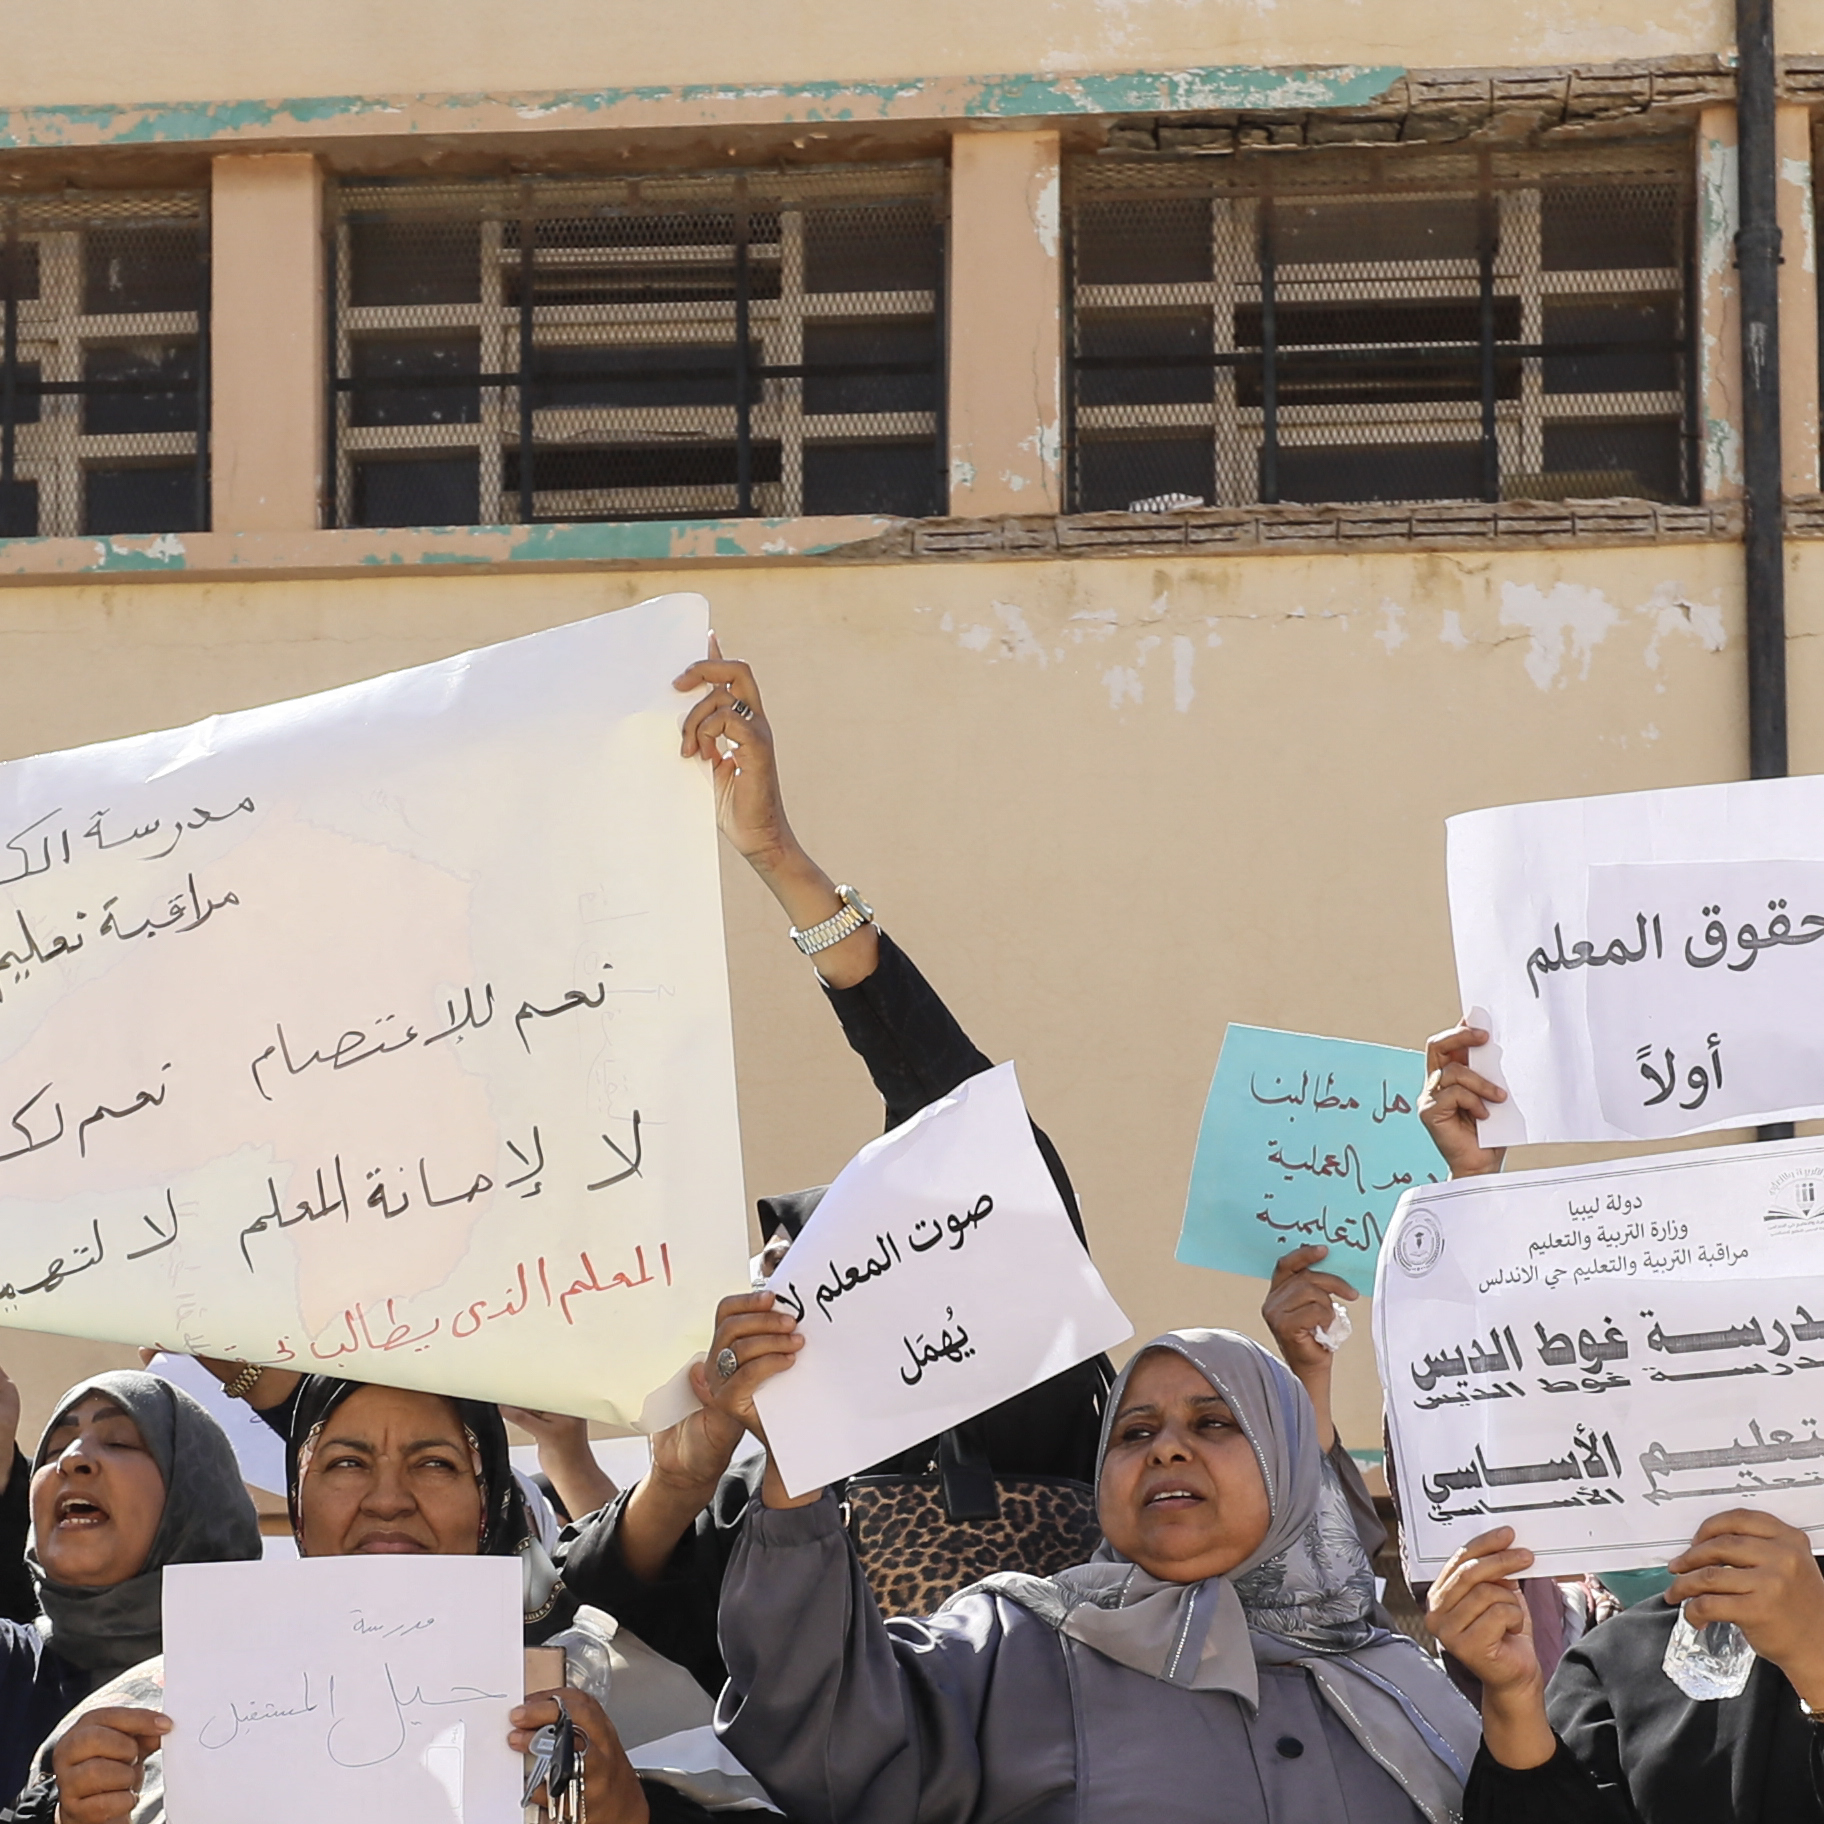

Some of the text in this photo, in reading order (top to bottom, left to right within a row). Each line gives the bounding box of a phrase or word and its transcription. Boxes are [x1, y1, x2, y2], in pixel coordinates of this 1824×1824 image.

[84, 792, 255, 859] مدرسة
[100, 873, 240, 940] مراقبة
[1526, 911, 1663, 999] المعلم
[515, 963, 613, 1054] نعم
[78, 1062, 172, 1158] نعم
[1372, 1078, 1412, 1124] هل
[587, 1109, 643, 1191] لا
[1268, 1140, 1366, 1195] العملية
[127, 1188, 178, 1260] لا
[240, 1154, 349, 1273] المعلم
[1529, 1220, 1688, 1259] وزارة التربية والتعليم
[1568, 1194, 1642, 1221] دولة ليبيا
[560, 1242, 671, 1325] المعلم
[774, 1194, 993, 1323] صوت المعلم لا
[1410, 1323, 1524, 1391] الديس
[1533, 1315, 1629, 1376] غوط
[1422, 1422, 1623, 1502] الأساسي
[351, 1610, 434, 1638] مدرسة
